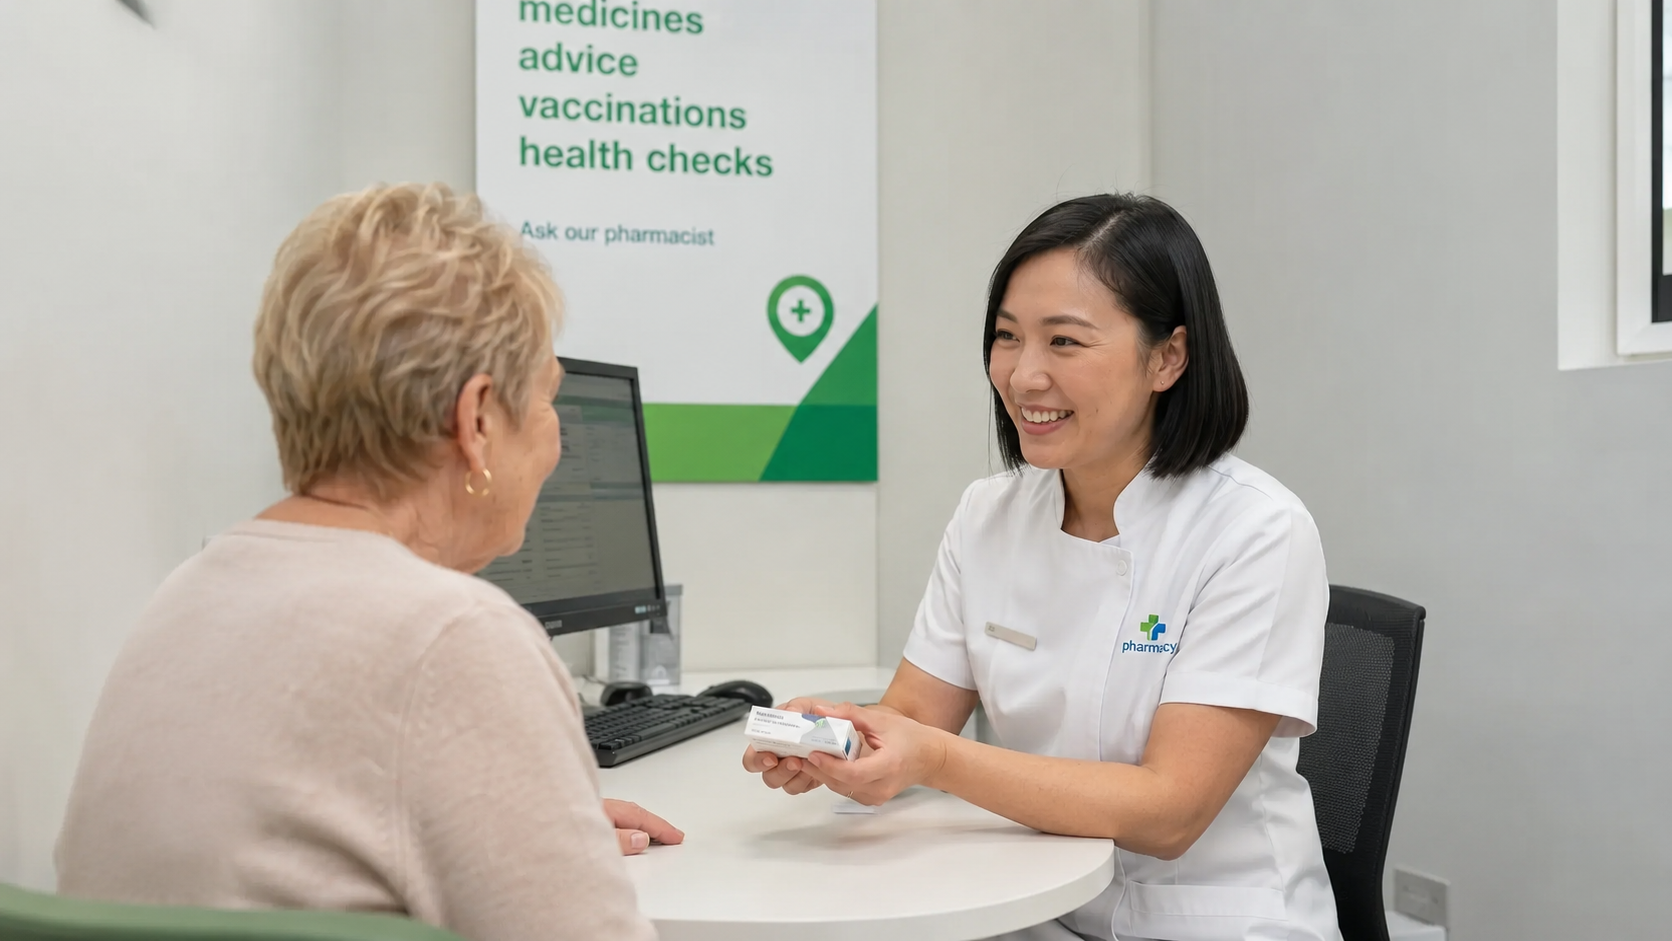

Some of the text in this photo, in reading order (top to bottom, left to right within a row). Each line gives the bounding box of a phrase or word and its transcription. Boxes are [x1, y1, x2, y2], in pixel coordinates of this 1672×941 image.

[519, 0, 704, 34] medicines
[519, 42, 638, 77] advice
[519, 93, 747, 130] vaccinations
[519, 136, 773, 177] health checks
[520, 220, 715, 246] Ask our pharmacist
